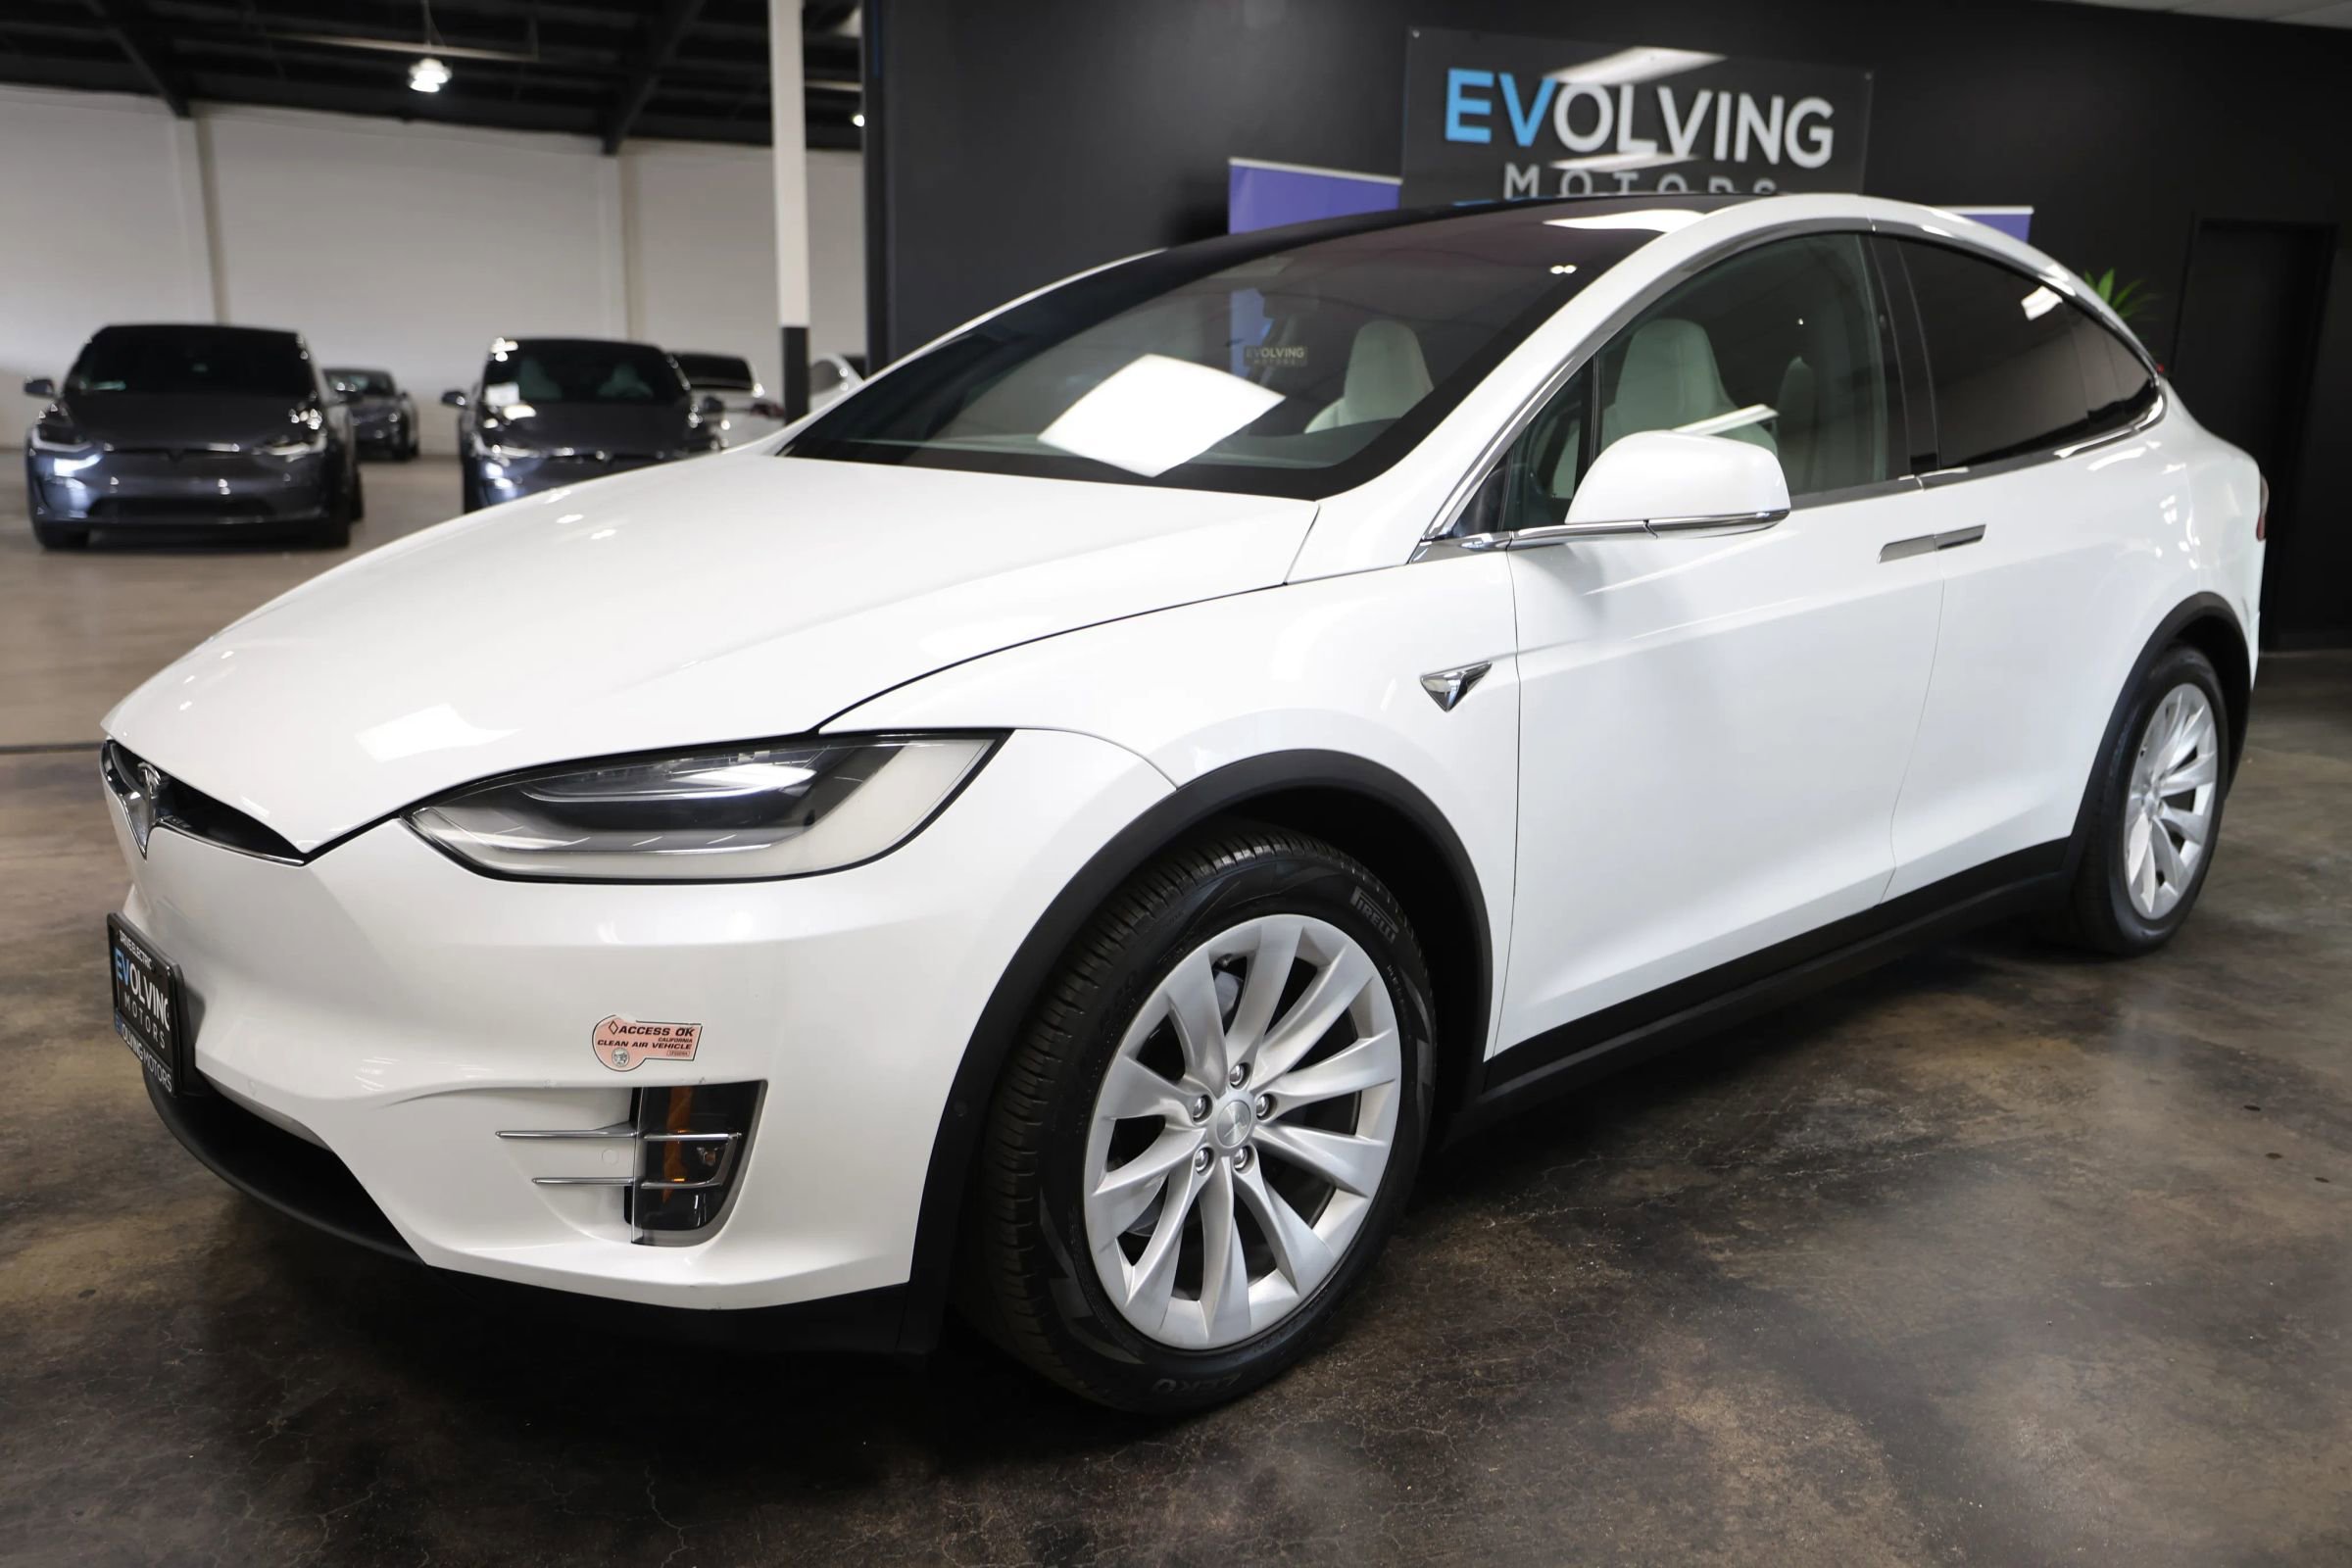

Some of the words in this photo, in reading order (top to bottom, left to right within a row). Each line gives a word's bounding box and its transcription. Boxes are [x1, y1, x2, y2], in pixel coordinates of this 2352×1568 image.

[1445, 68, 1836, 169] EVOLVING
[1350, 886, 1399, 944] PIRELLI
[124, 992, 166, 1050] MOTORS
[597, 1039, 629, 1048] CLEAN
[652, 1042, 693, 1051] VEHICLE
[618, 1025, 671, 1037] ACCESS
[674, 1026, 696, 1038] OK
[143, 1048, 172, 1093] MOTORS
